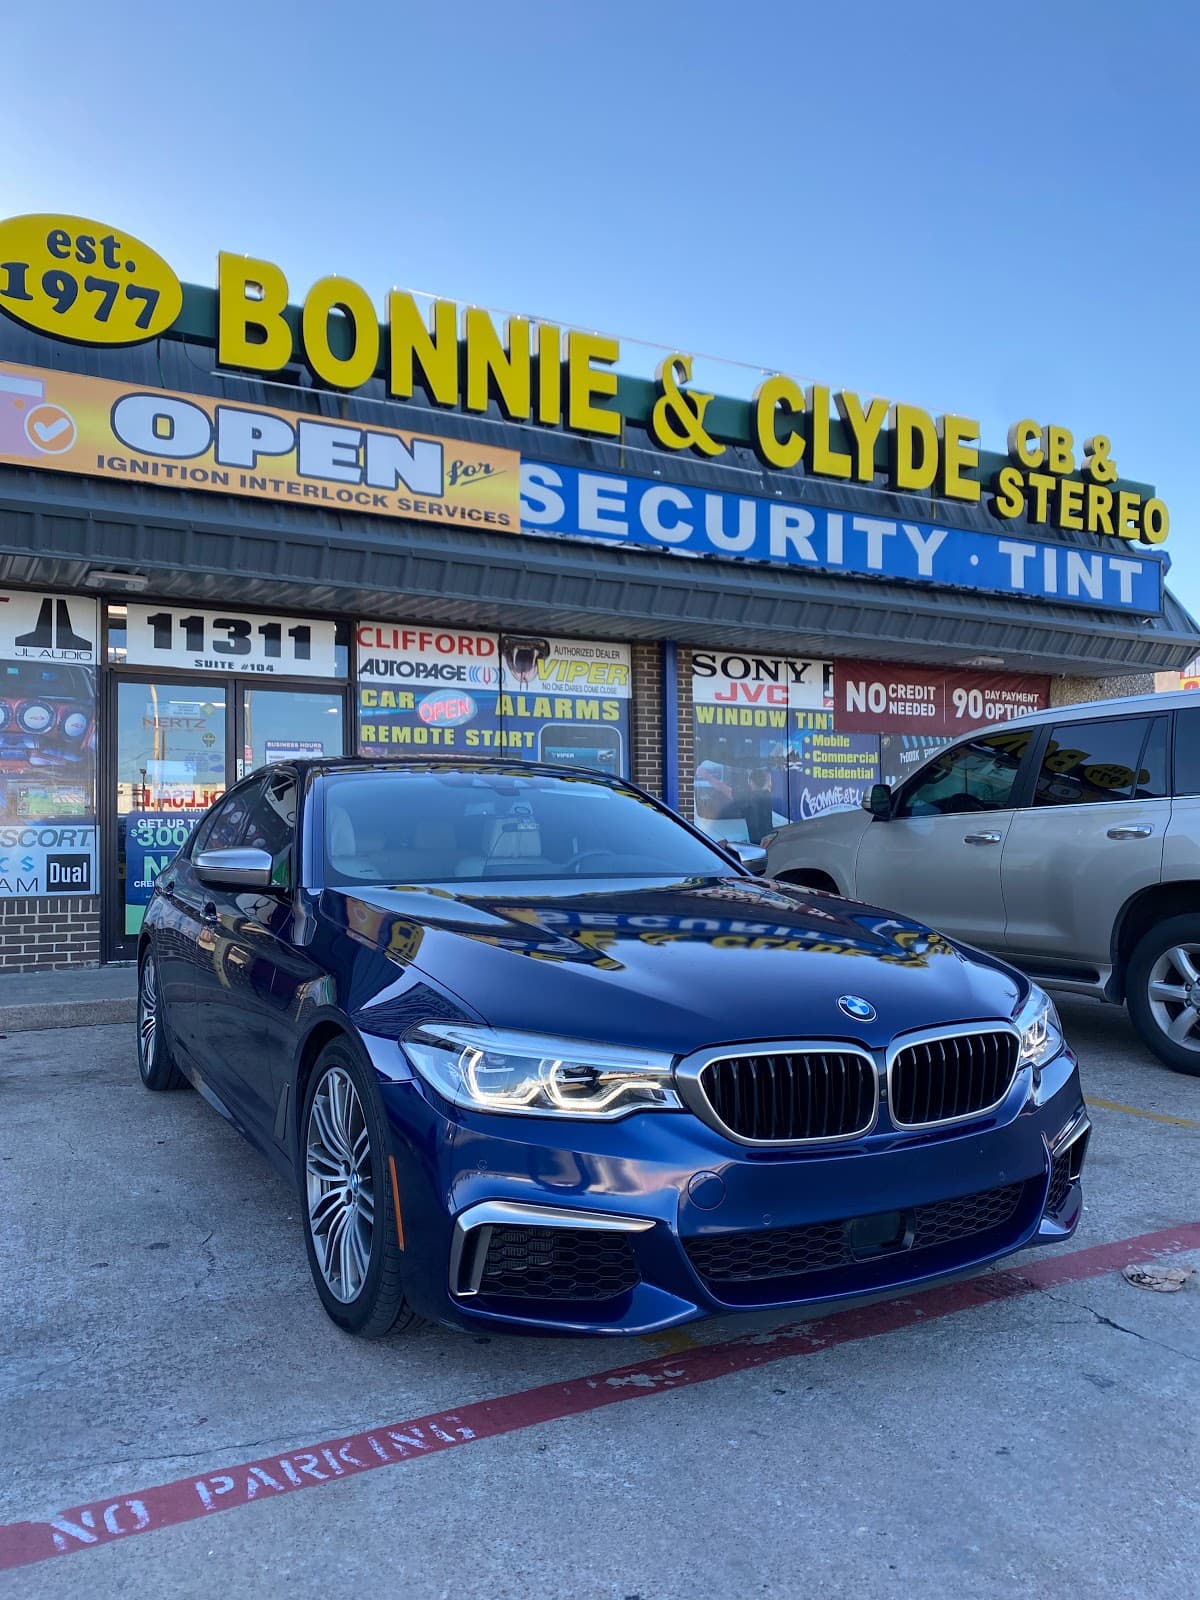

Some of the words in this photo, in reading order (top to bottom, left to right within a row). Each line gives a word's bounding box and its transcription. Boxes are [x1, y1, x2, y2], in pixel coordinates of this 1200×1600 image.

[47, 229, 136, 273] est.
[0, 262, 160, 329] 1977
[217, 250, 622, 437] BONNIE
[652, 353, 726, 457] &
[754, 375, 981, 502] CLYDE
[110, 392, 444, 498] OPEN
[447, 460, 497, 486] for
[1011, 419, 1075, 475] CB
[1086, 434, 1119, 483] &
[97, 454, 230, 486] IGNITION
[240, 474, 388, 509] INTERLOCK
[397, 497, 511, 527] SERVICES
[995, 466, 1170, 544] STEREO
[520, 463, 948, 577] SECURITY
[998, 540, 1143, 604] TINT
[147, 612, 311, 661] 11311
[357, 626, 495, 657] CLIFFORD
[15, 647, 36, 658] JL
[38, 649, 92, 661] AUDIO
[194, 659, 235, 671] SUITE
[241, 662, 274, 673] #104
[554, 645, 594, 658] AUTHORIZED
[595, 647, 620, 660] DEALER
[358, 658, 467, 682] AUTOPAGE
[536, 658, 630, 687] VIPER
[692, 653, 812, 684] SONY
[361, 689, 415, 709] CAR
[714, 681, 790, 705] JVC
[846, 680, 887, 714] NO
[888, 684, 936, 700] CREDIT
[952, 687, 984, 720] 90
[985, 690, 1000, 700] DAY
[1002, 691, 1040, 704] PAYMENT
[418, 696, 471, 723] OPEN
[495, 694, 620, 721] ALARMS
[696, 705, 787, 728] WINDOW
[888, 701, 936, 717] NEEDED
[361, 725, 455, 746] REMOTE
[466, 729, 535, 748] START
[813, 734, 850, 747] Mobile
[812, 750, 878, 764] Commercial
[813, 766, 874, 780] Residential
[137, 818, 163, 828] GET
[166, 818, 184, 828] UP
[187, 818, 200, 829] T
[0, 828, 95, 848] SCORT
[49, 862, 88, 884] Dual
[50, 1499, 150, 1552] NO
[195, 1414, 477, 1511] PARKING
